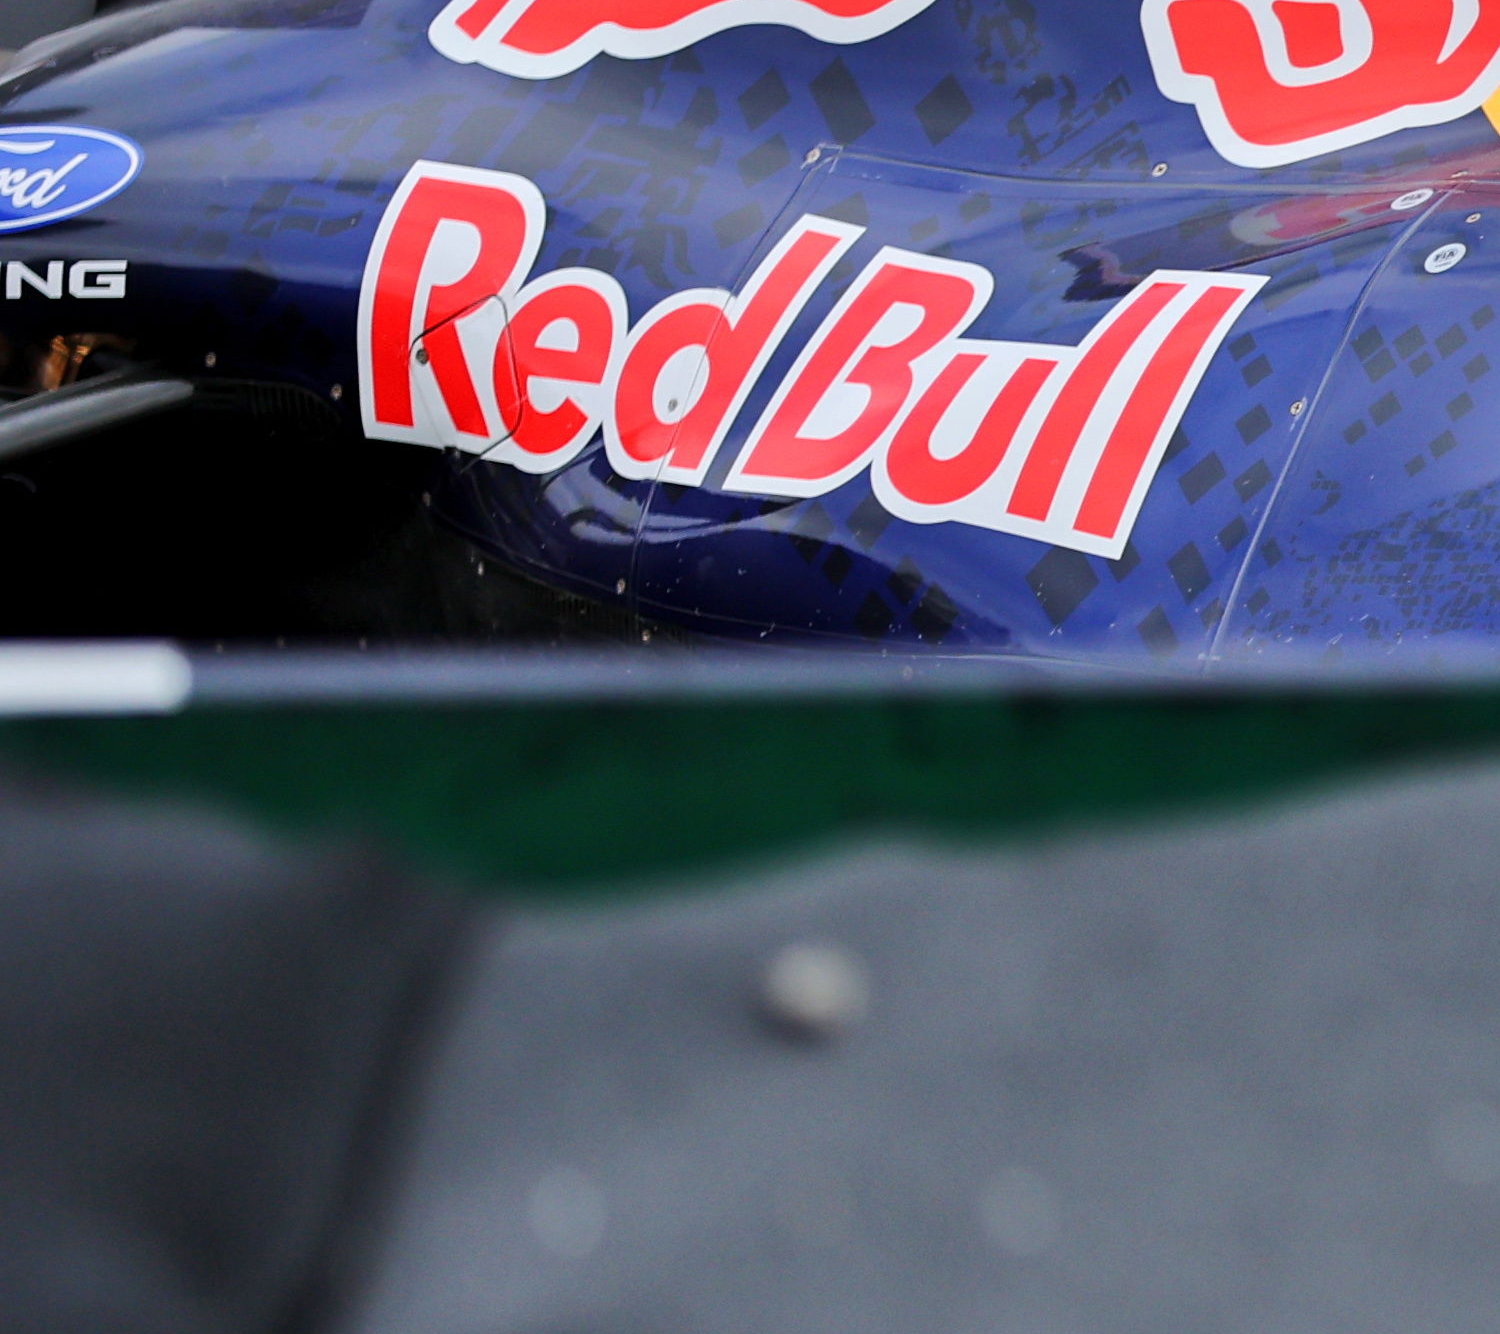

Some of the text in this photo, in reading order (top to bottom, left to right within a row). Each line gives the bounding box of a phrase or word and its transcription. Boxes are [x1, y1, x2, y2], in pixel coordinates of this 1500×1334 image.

[0, 152, 89, 209] rd
[358, 159, 1271, 560] Red Bull
